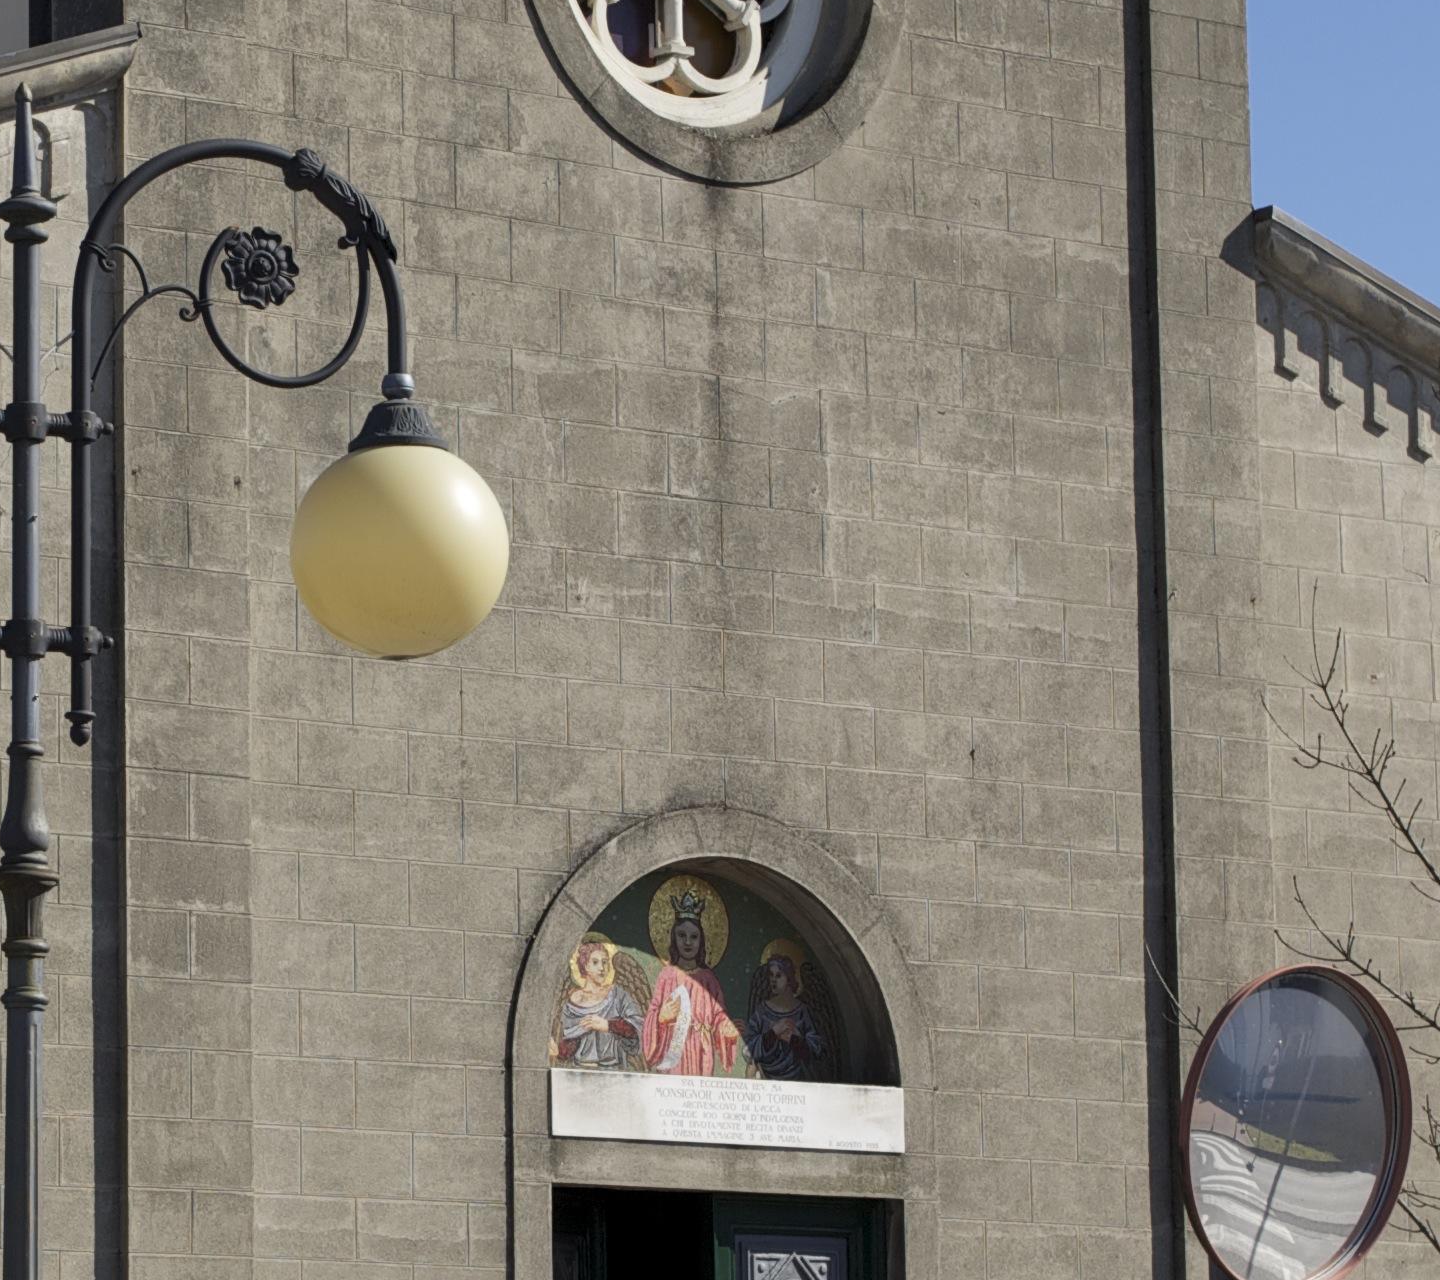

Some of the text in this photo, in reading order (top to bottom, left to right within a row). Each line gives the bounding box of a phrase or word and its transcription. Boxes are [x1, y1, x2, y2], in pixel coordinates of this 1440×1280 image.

[700, 1079, 748, 1090] ECCELLENZA
[655, 1087, 807, 1105] MONSIGNOR ANTONIO TORRINI
[658, 1108, 697, 1119] CONCEDE
[703, 1110, 717, 1119] 100
[741, 1104, 750, 1112] DI
[671, 1119, 684, 1128] CHI
[745, 1123, 773, 1132] RECITA
